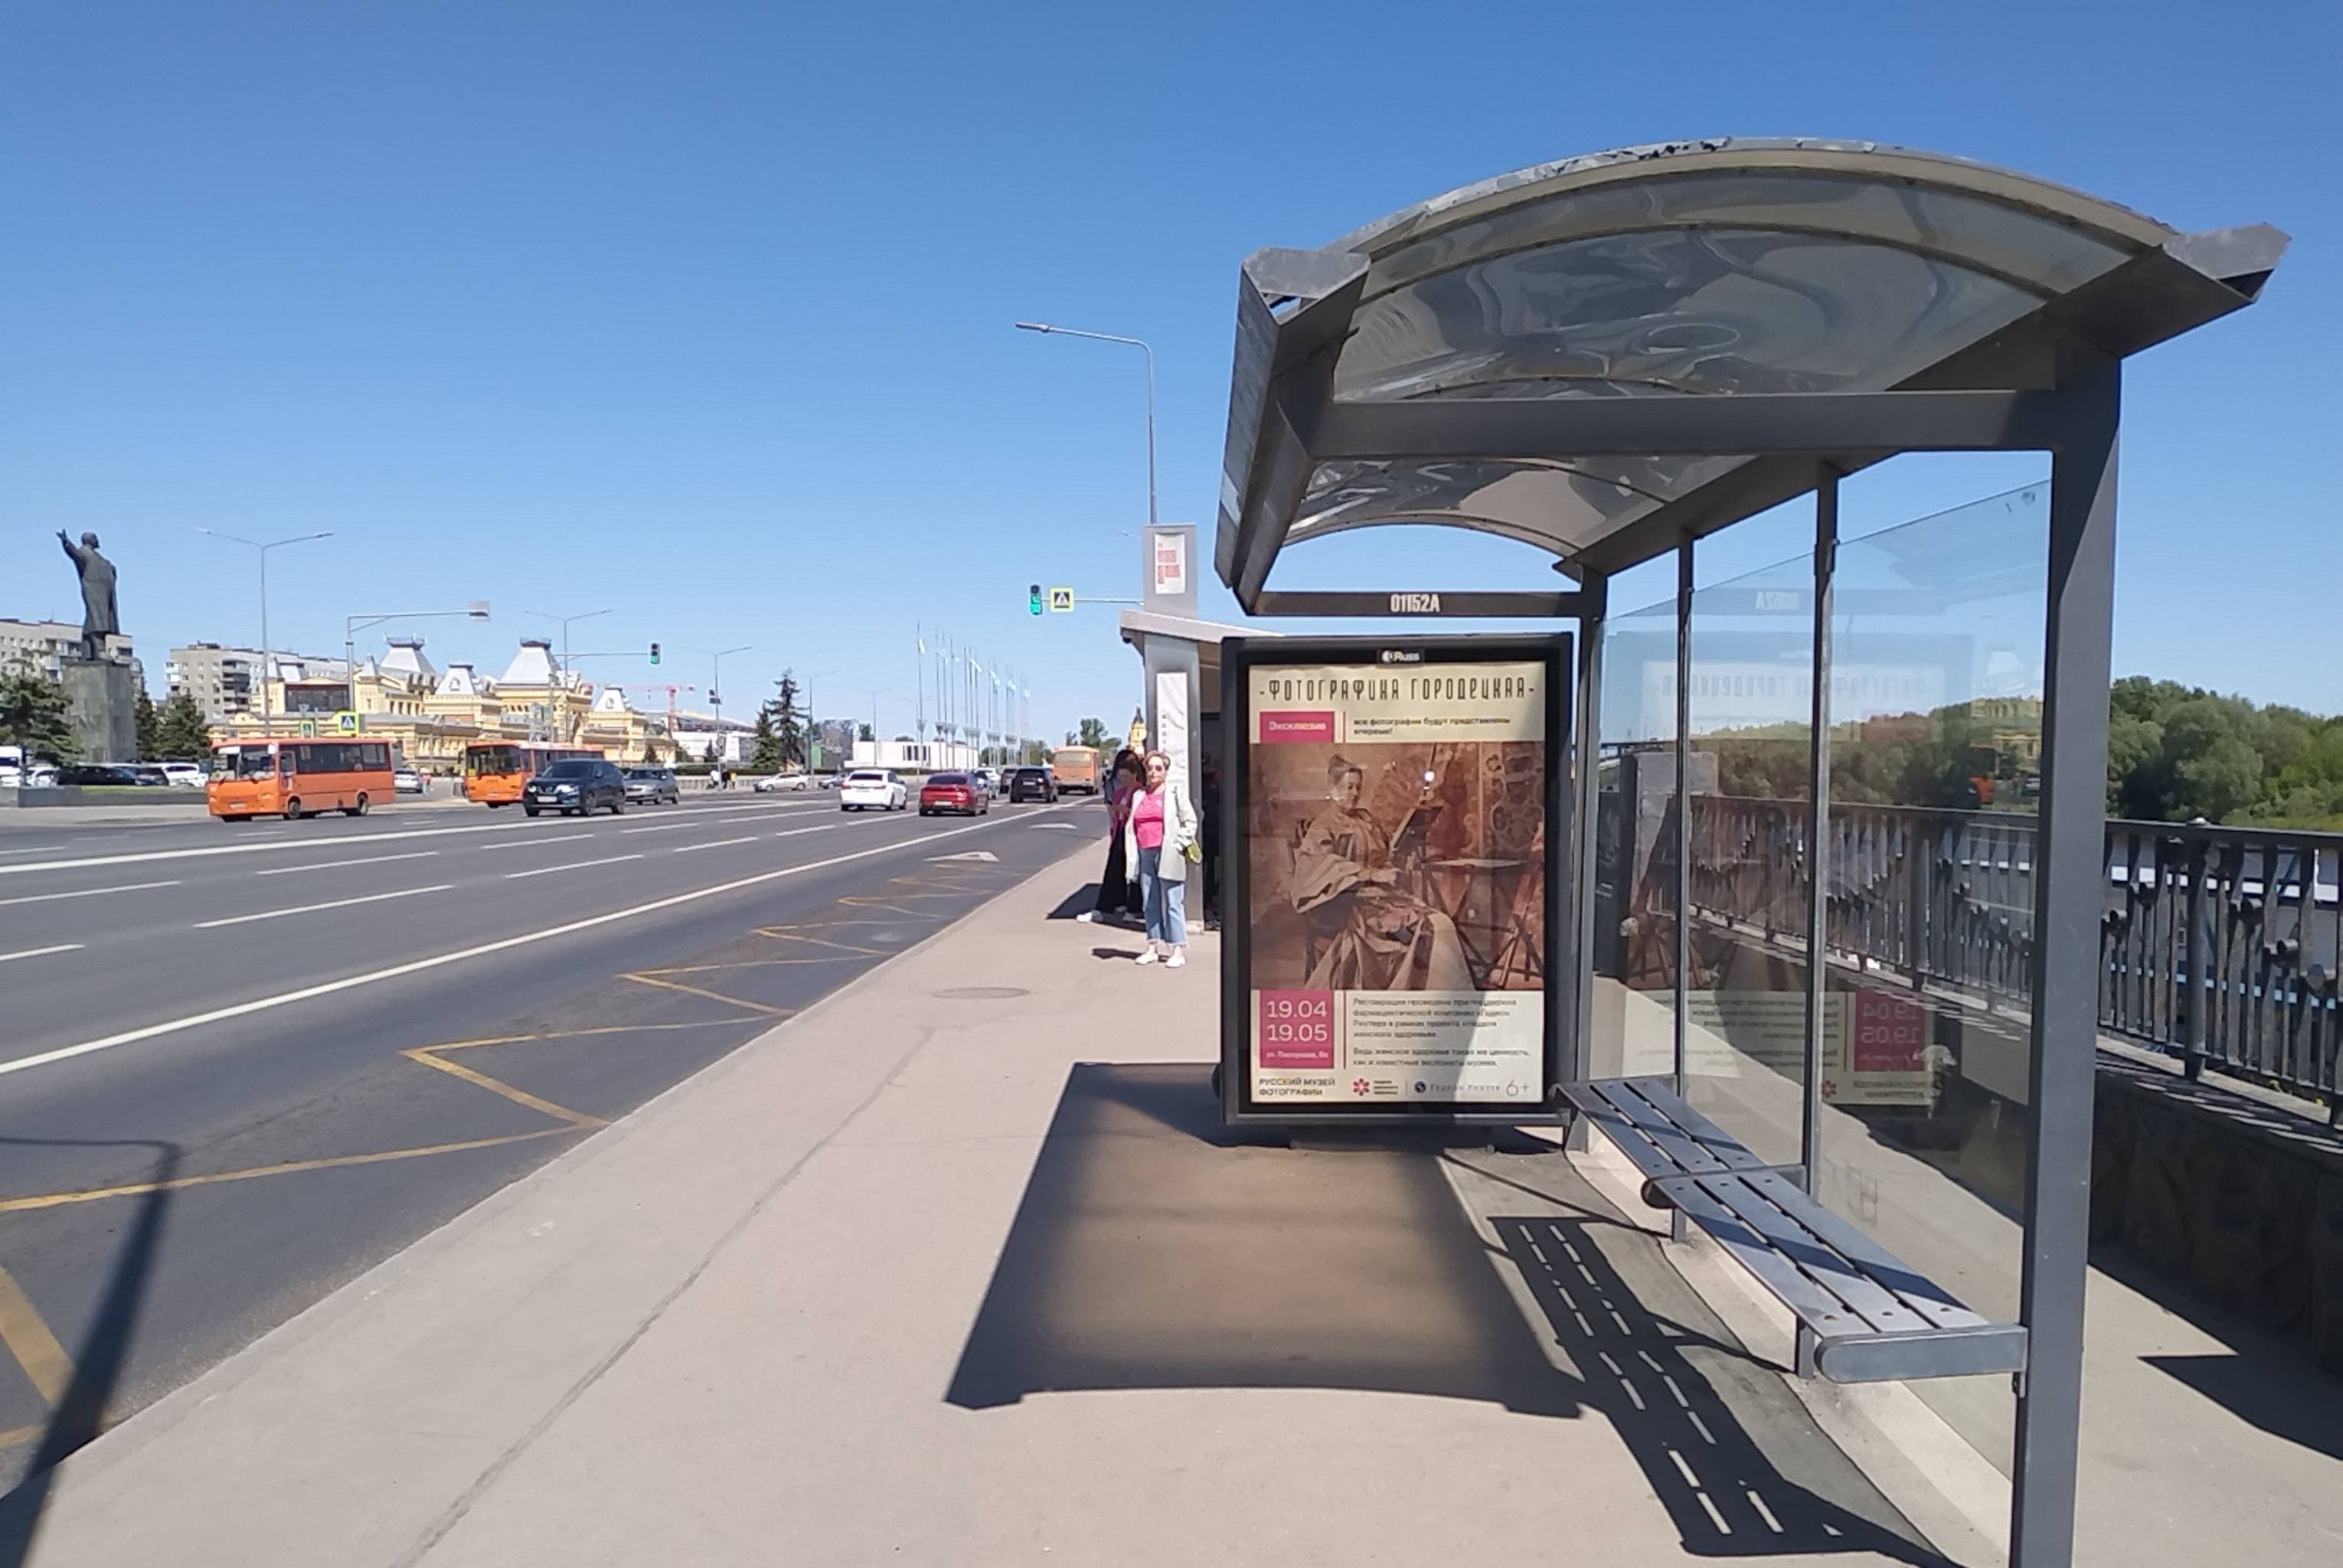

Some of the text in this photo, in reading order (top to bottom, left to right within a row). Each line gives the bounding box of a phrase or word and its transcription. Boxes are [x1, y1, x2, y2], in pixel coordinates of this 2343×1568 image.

[1267, 1000, 1327, 1018] 19.04
[1267, 1023, 1328, 1041] 19.05
[1506, 1079, 1529, 1097] 6+
